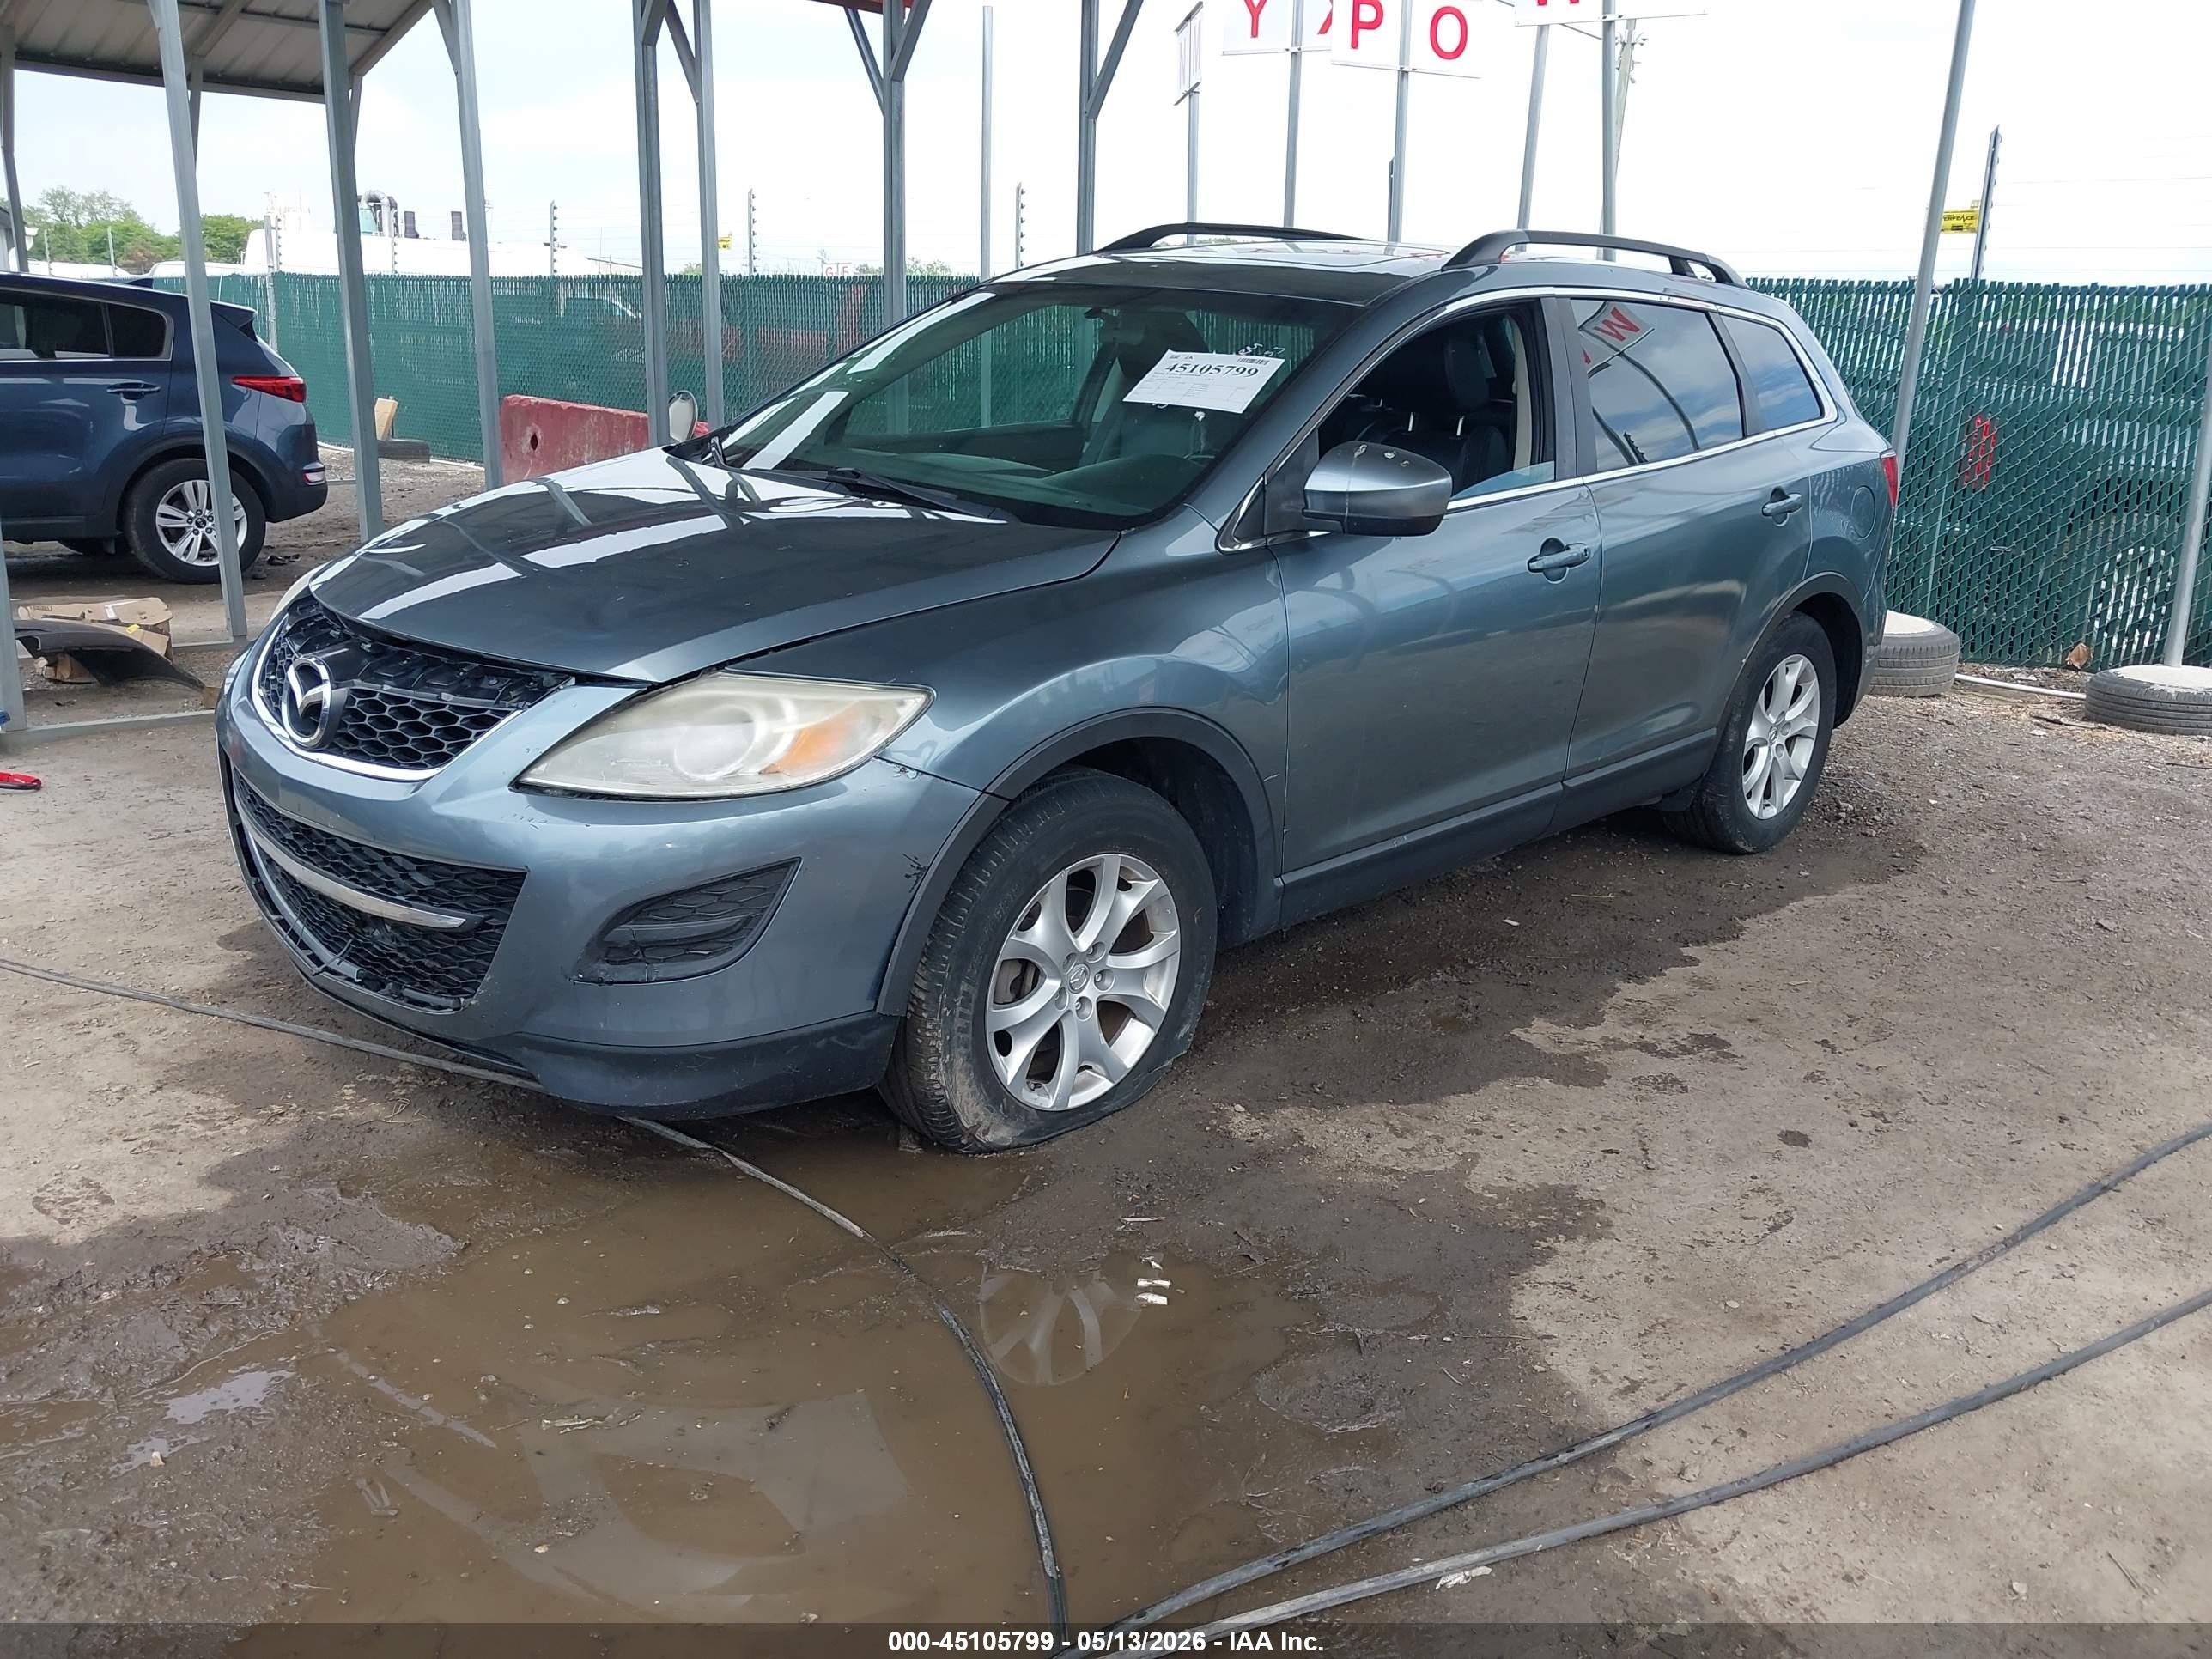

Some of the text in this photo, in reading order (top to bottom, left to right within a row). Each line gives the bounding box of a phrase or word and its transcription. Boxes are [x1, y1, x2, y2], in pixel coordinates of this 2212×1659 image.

[1243, 0, 1267, 38] Y
[1351, 0, 1384, 49] P
[1166, 362, 1259, 378] 45105799
